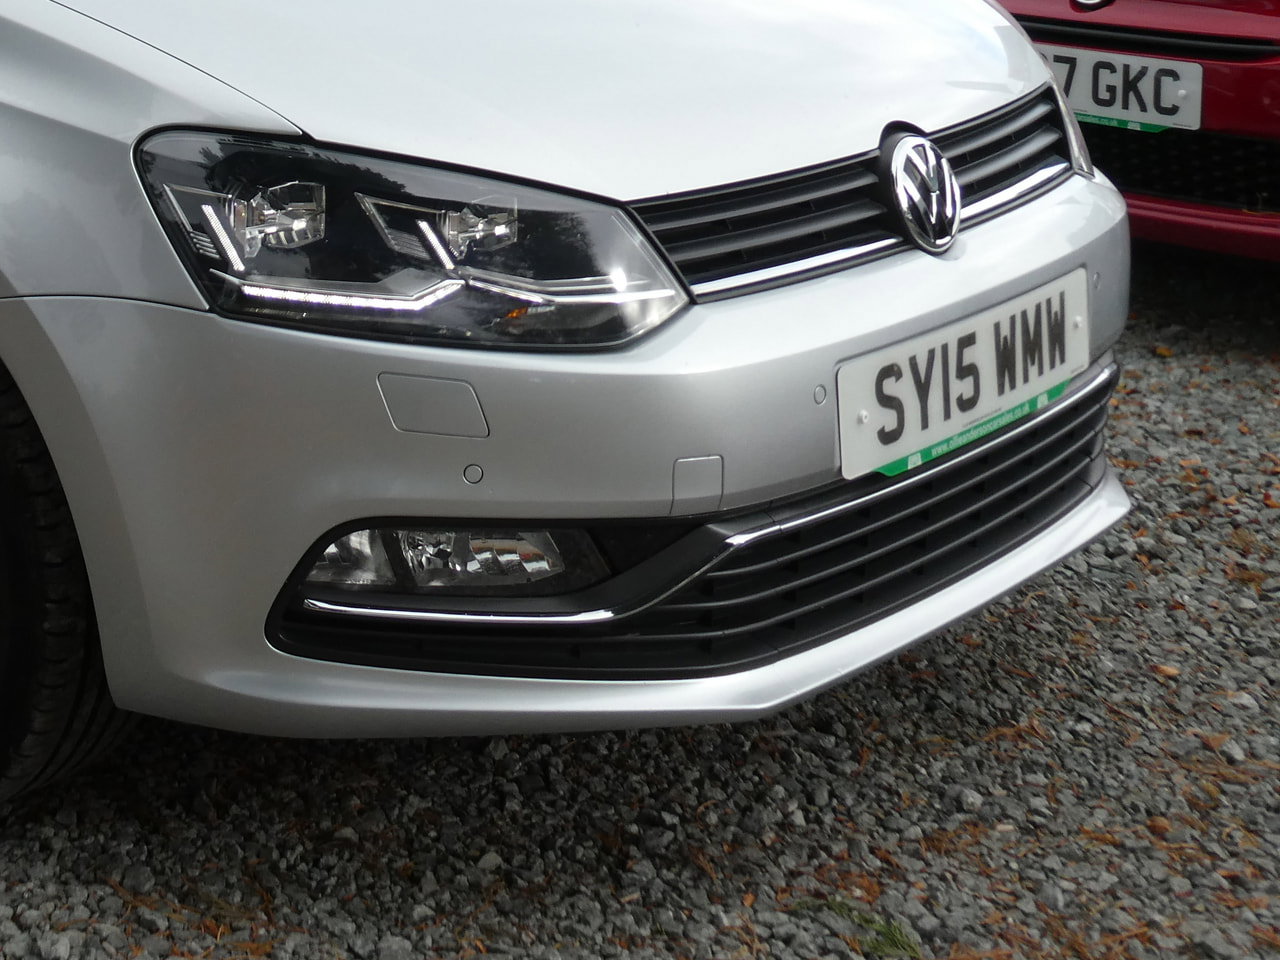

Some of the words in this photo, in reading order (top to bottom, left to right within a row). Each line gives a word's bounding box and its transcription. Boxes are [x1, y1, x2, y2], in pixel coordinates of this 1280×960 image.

[1091, 60, 1181, 116] GKC
[874, 330, 982, 446] SY15
[993, 290, 1067, 398] WMW
